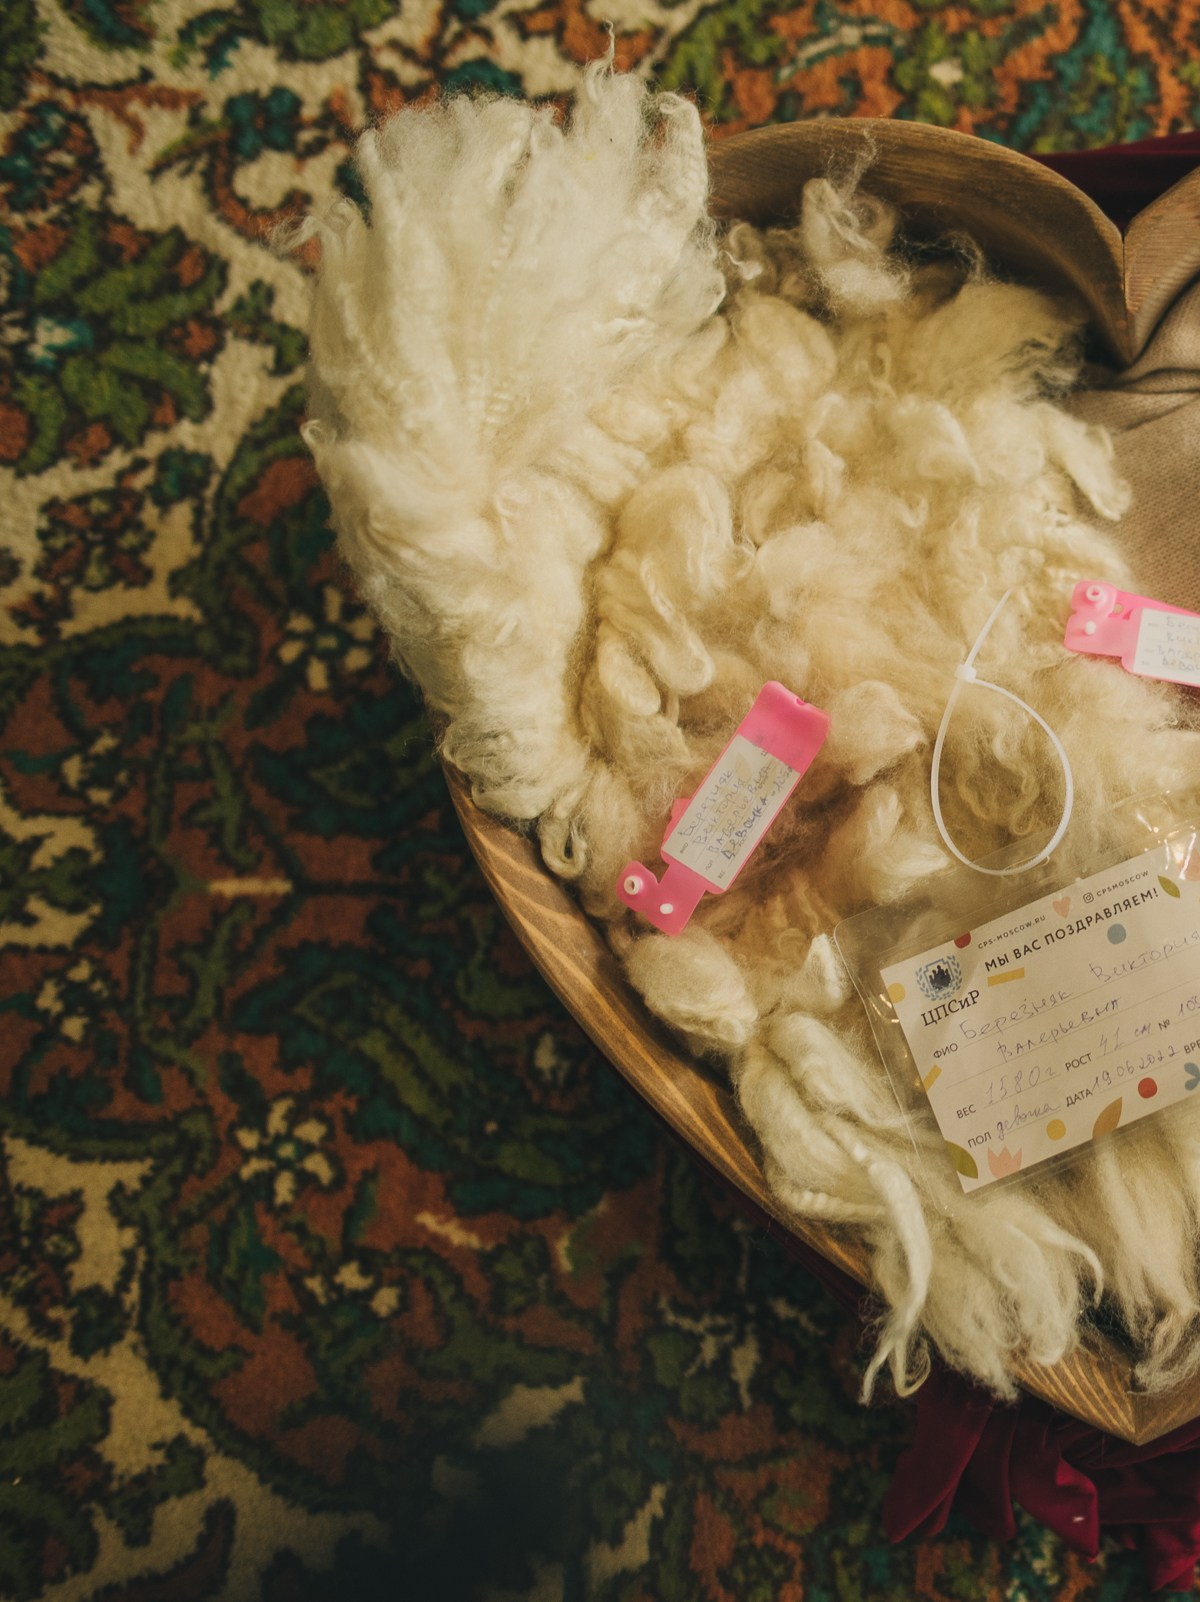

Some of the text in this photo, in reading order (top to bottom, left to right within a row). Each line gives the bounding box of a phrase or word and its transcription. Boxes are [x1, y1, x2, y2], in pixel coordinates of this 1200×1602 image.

[977, 915, 1046, 949] CPS-MOSCOW.RU
[984, 887, 1159, 972] МЫ ВАС ПОЗДРАВЛЯЕМ!
[920, 989, 980, 1026] ЦПСиР
[933, 1042, 958, 1059] ФИО
[1088, 931, 1200, 982] Виктория
[956, 1104, 977, 1119] ВЕС
[1065, 1052, 1092, 1072] РОСТ
[1158, 1018, 1171, 1031] №
[967, 1131, 992, 1149] ПОЛ
[1066, 1088, 1094, 1108] ДАТА
